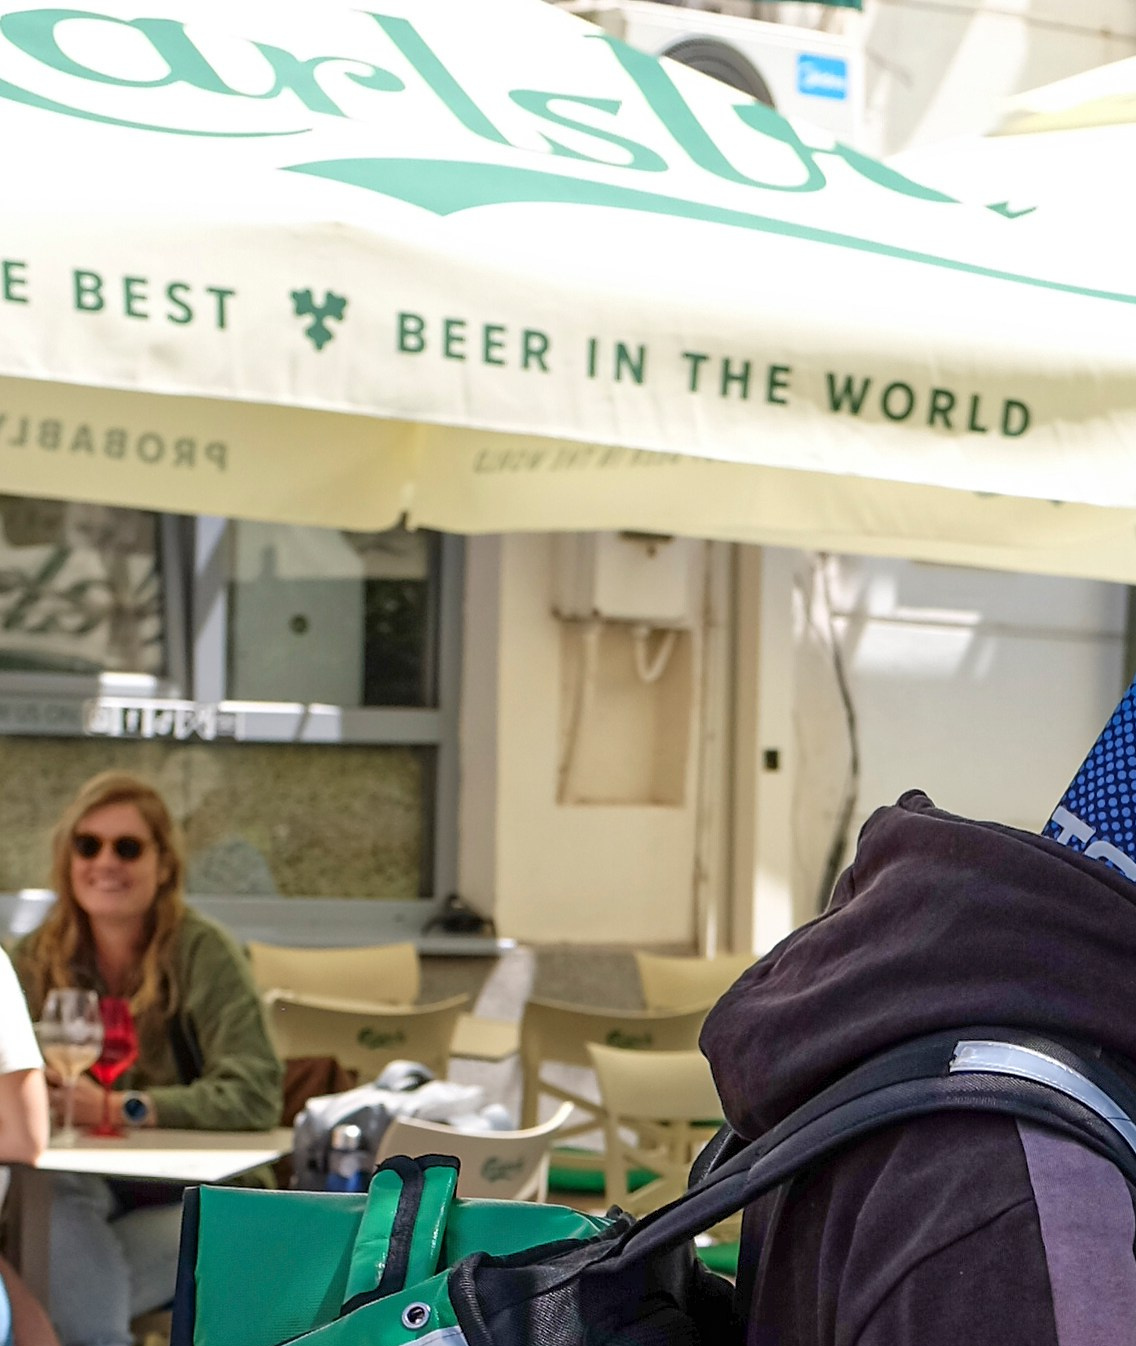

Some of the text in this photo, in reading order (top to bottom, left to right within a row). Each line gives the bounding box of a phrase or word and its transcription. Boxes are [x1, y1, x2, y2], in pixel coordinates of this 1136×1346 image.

[72, 268, 236, 330] BEST
[396, 312, 551, 374] BEER
[586, 336, 646, 385] IN
[681, 351, 792, 406] THE
[825, 371, 1032, 439] WORLD
